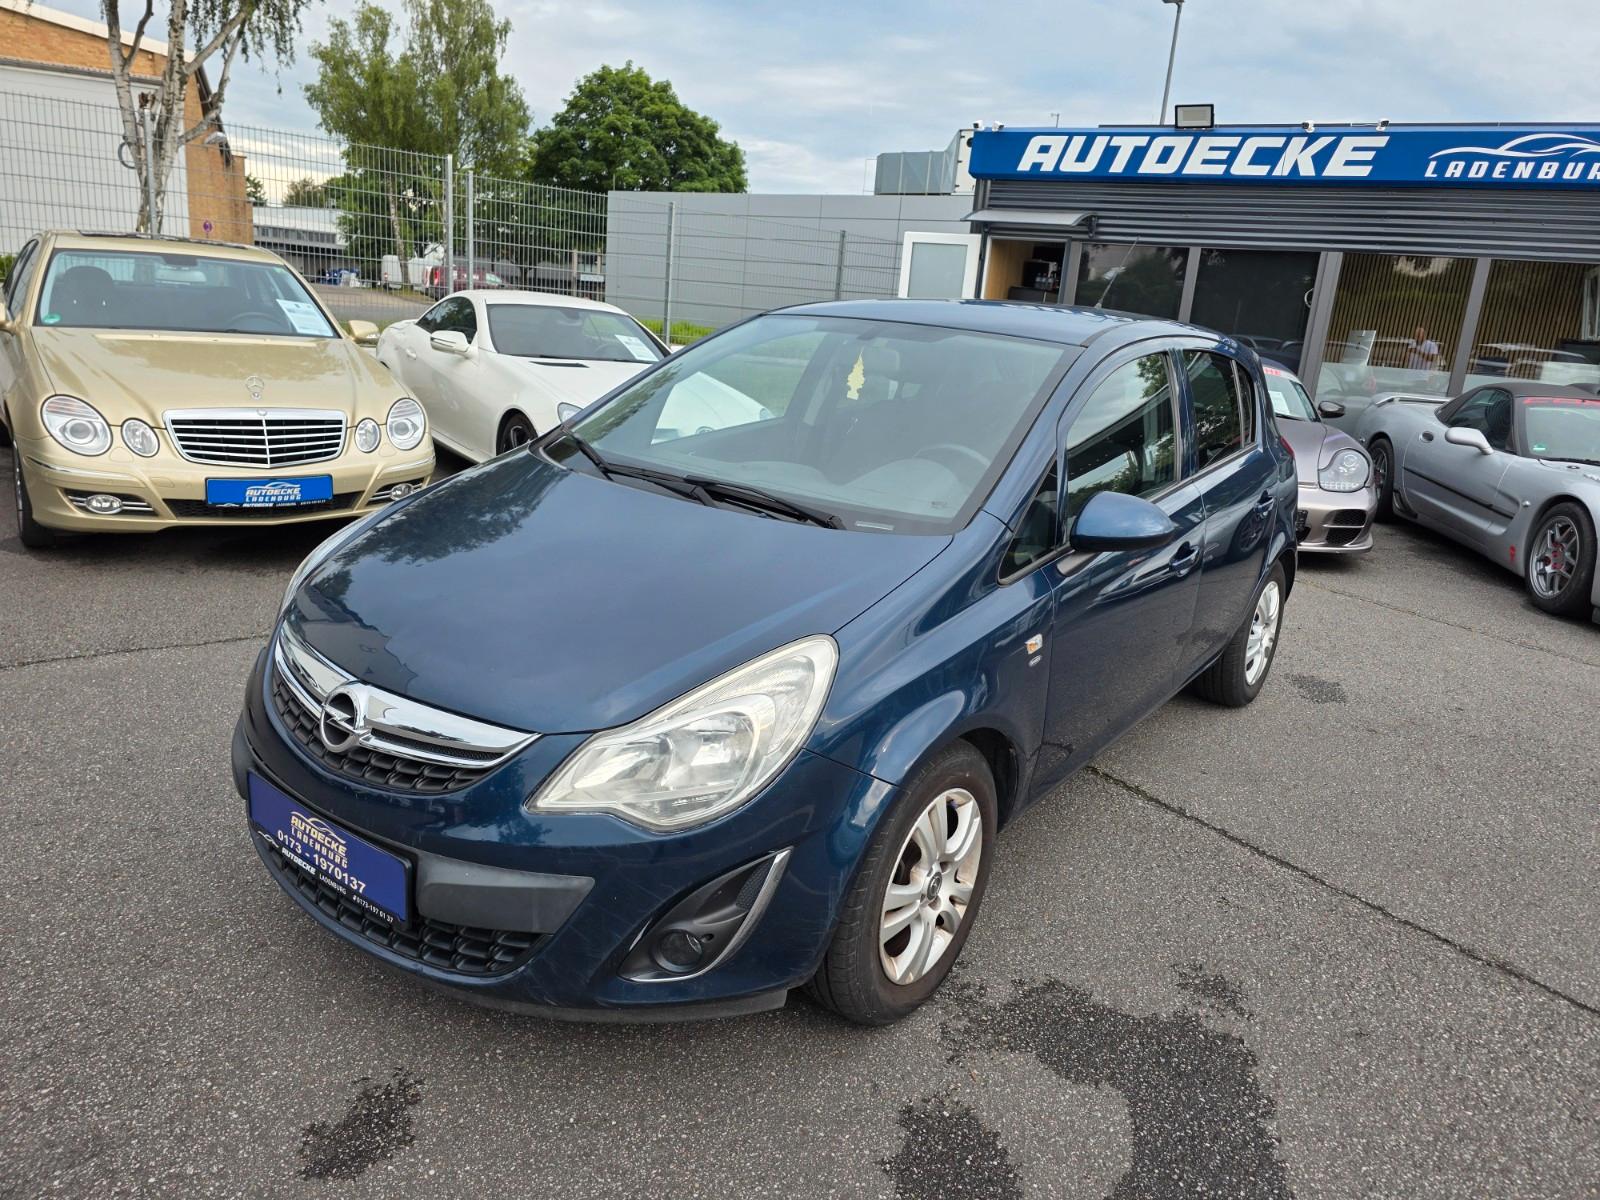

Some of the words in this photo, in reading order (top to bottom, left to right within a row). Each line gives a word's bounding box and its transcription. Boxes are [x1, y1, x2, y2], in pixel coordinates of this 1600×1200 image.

[1016, 135, 1391, 177] AUTOECKE
[245, 487, 302, 496] AUTOECKE
[291, 815, 347, 856] AUTOECKE
[291, 826, 348, 868] LADENBURG
[277, 830, 302, 854] 0173
[313, 854, 366, 894] 1970137
[281, 847, 316, 875] AUTOECKE
